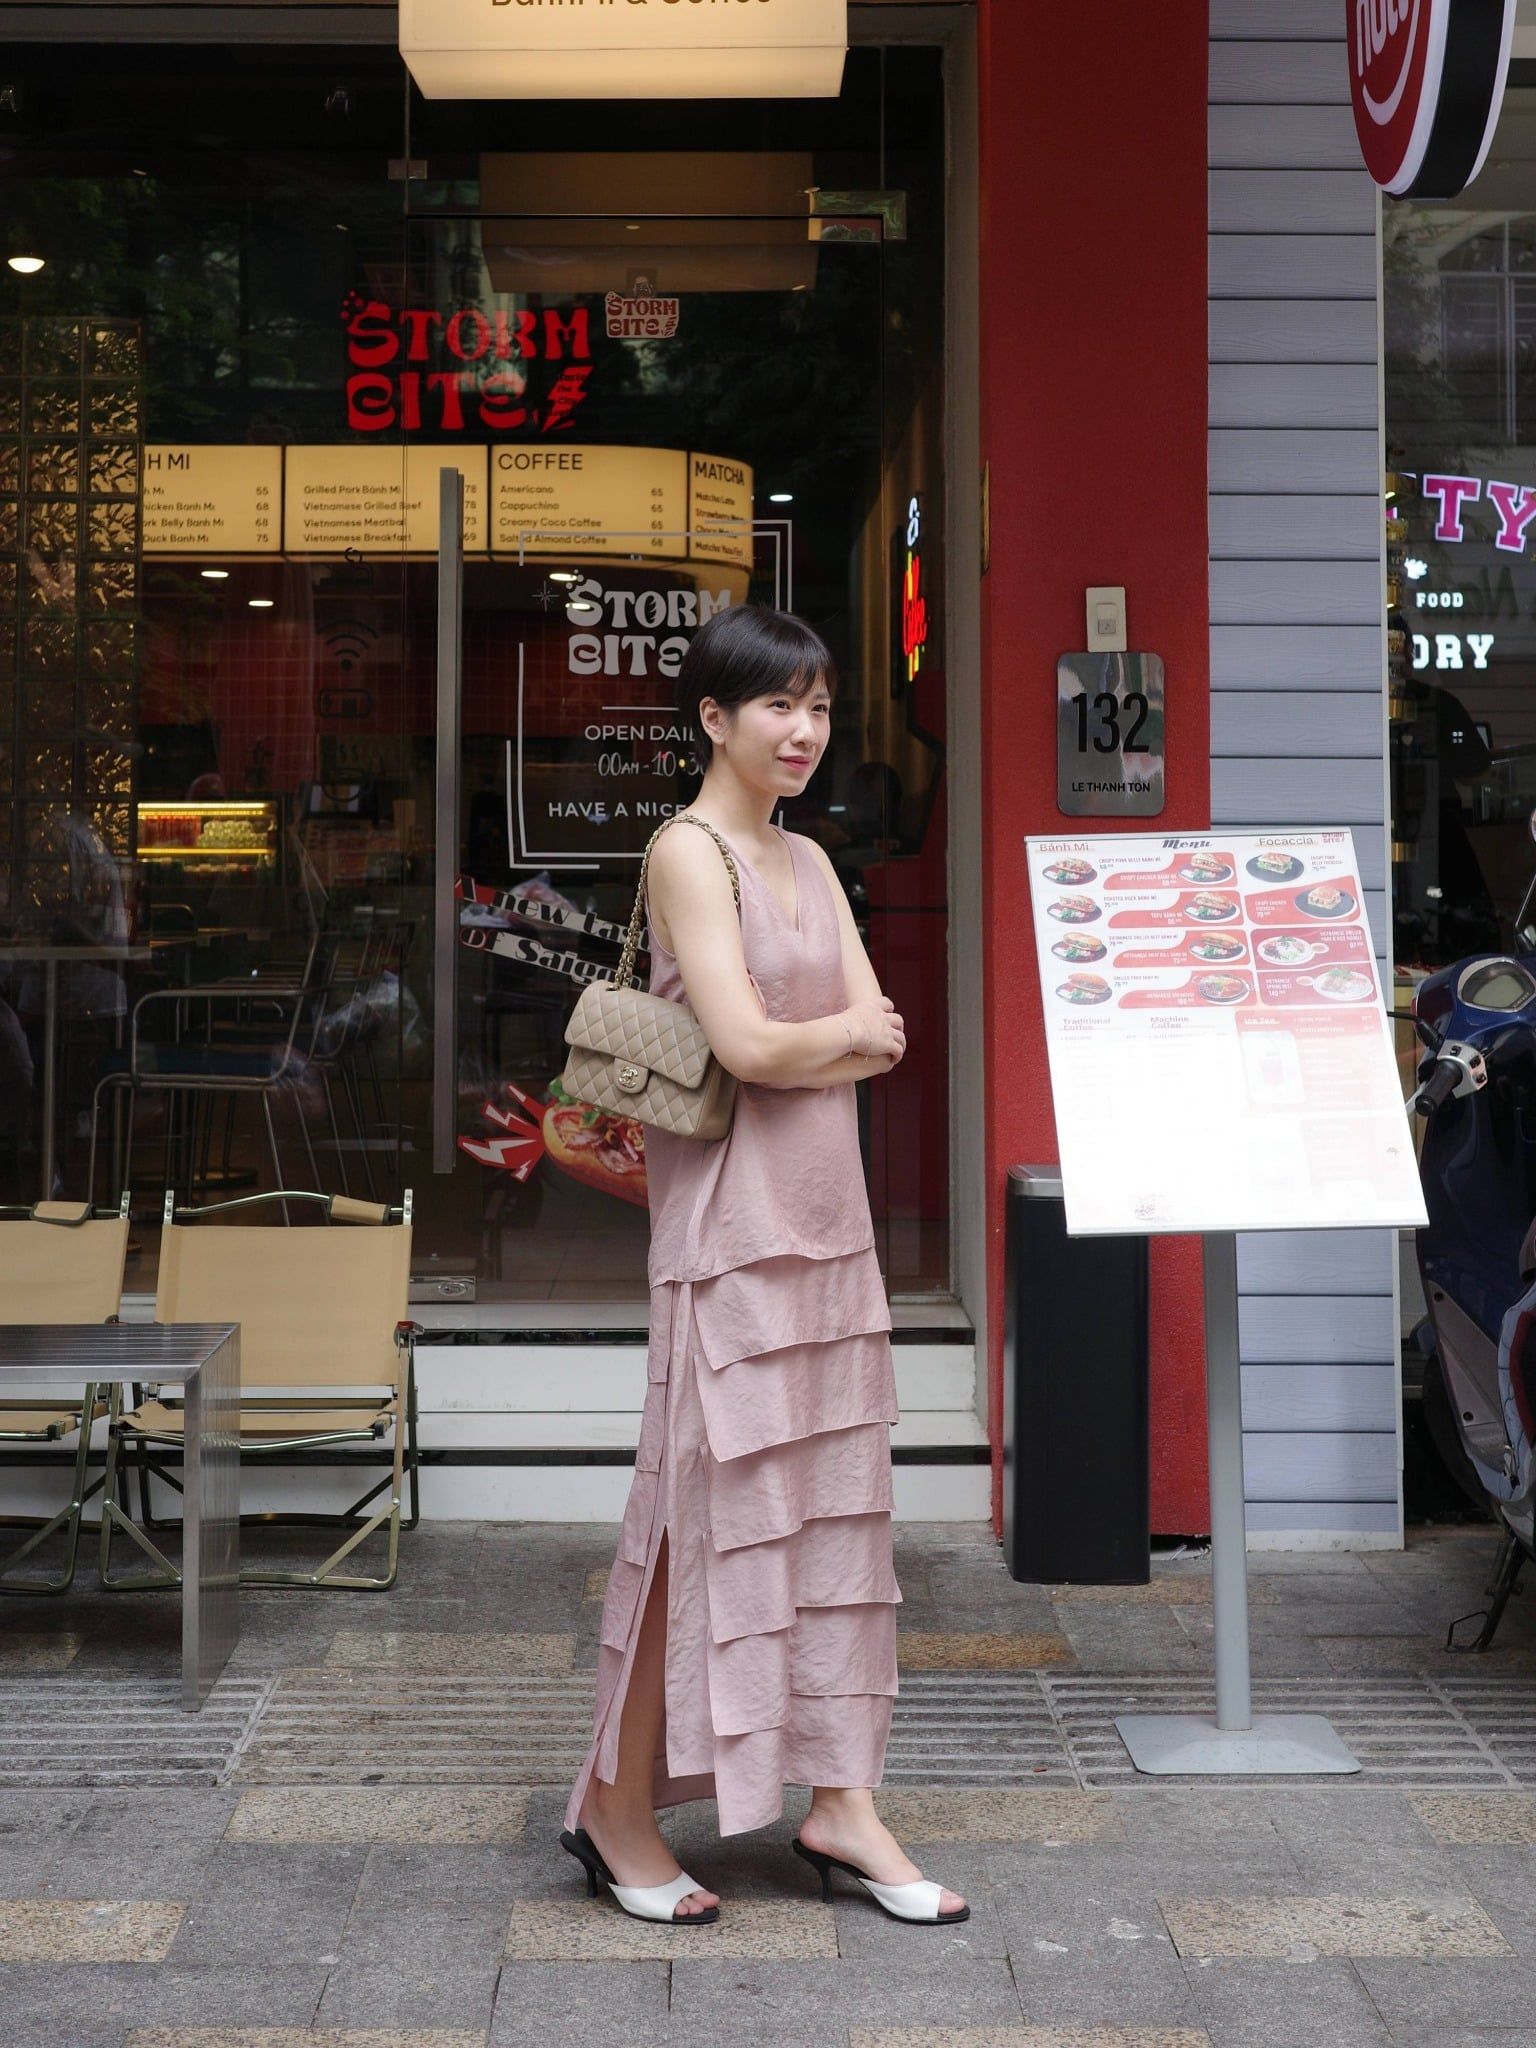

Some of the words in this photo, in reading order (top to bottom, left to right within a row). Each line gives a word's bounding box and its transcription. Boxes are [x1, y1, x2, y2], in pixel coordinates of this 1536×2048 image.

[607, 296, 677, 316] STORM
[608, 318, 659, 336] BITE
[346, 300, 590, 368] STORM
[346, 371, 527, 431] BITE
[168, 453, 190, 470] MI
[498, 453, 584, 471] COFFEE
[695, 460, 745, 486] MATCHA
[303, 485, 337, 494] Grilled
[338, 485, 360, 494] Pork
[464, 485, 477, 494] 78
[499, 485, 554, 494] Americano
[650, 488, 663, 497] 65
[255, 502, 269, 511] 68
[303, 501, 361, 511] Vietnamese
[363, 501, 397, 510] Grilled
[464, 500, 477, 510] 78
[499, 501, 560, 512] Cappuchino
[650, 504, 663, 513] 65
[161, 518, 184, 529] Belly
[255, 518, 269, 527] 68
[303, 518, 362, 528] Vietnamese
[464, 517, 477, 526] 73
[499, 518, 538, 529] Creamy
[539, 518, 567, 527] Coco
[568, 518, 602, 528] Coffee
[650, 520, 663, 530] 65
[143, 534, 167, 543] Duck
[256, 534, 269, 543] 75
[303, 533, 362, 542] Vietnamese
[534, 534, 571, 544] Almond
[573, 535, 607, 545] Coffee
[650, 538, 663, 547] 68
[565, 577, 732, 629] STORM
[1415, 592, 1464, 608] FOOD
[1072, 692, 1150, 753] 132
[584, 725, 645, 741] OPEN
[1073, 783, 1085, 792] LE
[1088, 783, 1125, 792] THANH
[1129, 783, 1150, 792] TON
[548, 801, 606, 818] HAVE
[614, 802, 629, 818] A
[636, 801, 688, 818] NICE
[1161, 838, 1213, 850] Menu
[1258, 836, 1315, 848] Focaccia
[455, 872, 478, 903] A
[492, 890, 571, 926] new
[1062, 1017, 1111, 1026] Traditional
[1150, 1015, 1190, 1023] Machine
